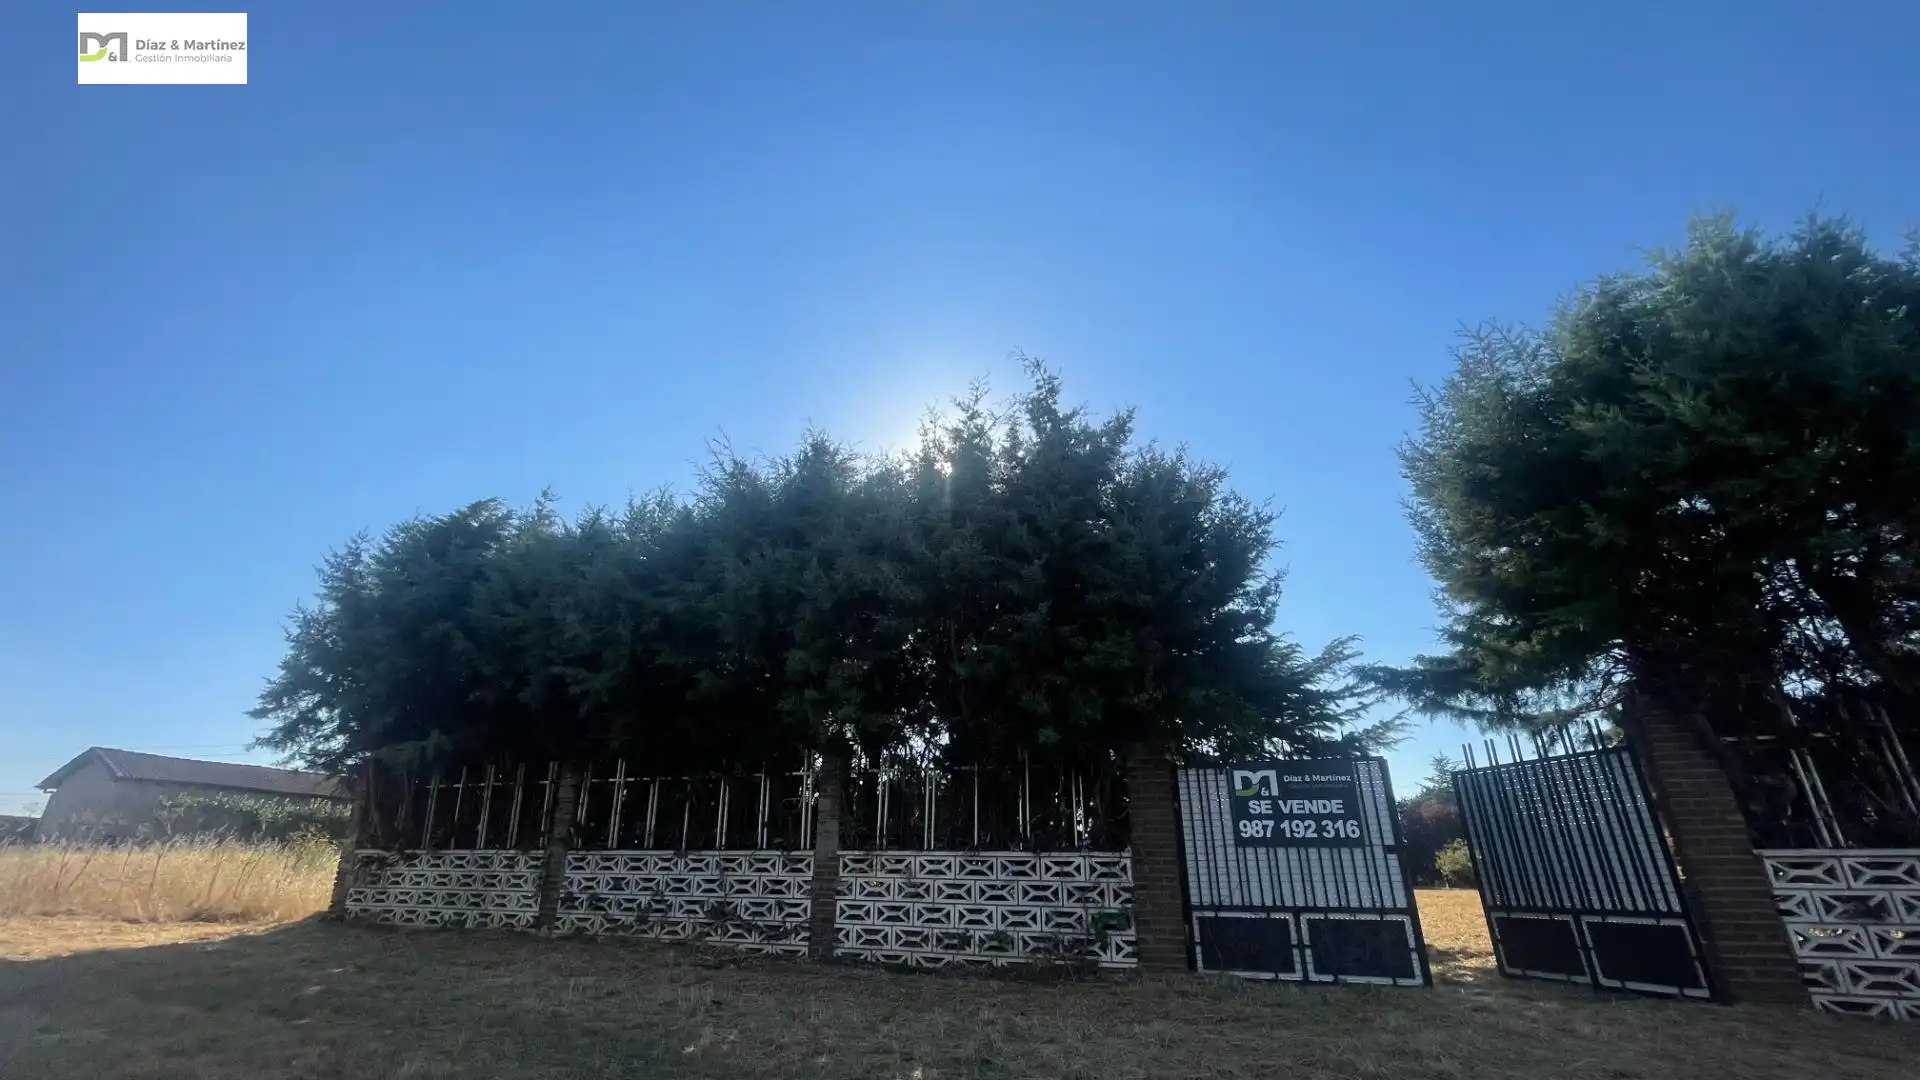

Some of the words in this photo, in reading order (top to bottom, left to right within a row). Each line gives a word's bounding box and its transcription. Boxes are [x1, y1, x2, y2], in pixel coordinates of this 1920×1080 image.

[1304, 774, 1311, 782] &
[1248, 800, 1273, 814] SE
[1278, 799, 1345, 814] VENDE
[1239, 820, 1275, 838] 987
[1280, 820, 1318, 838] 192
[1321, 820, 1360, 838] 316
